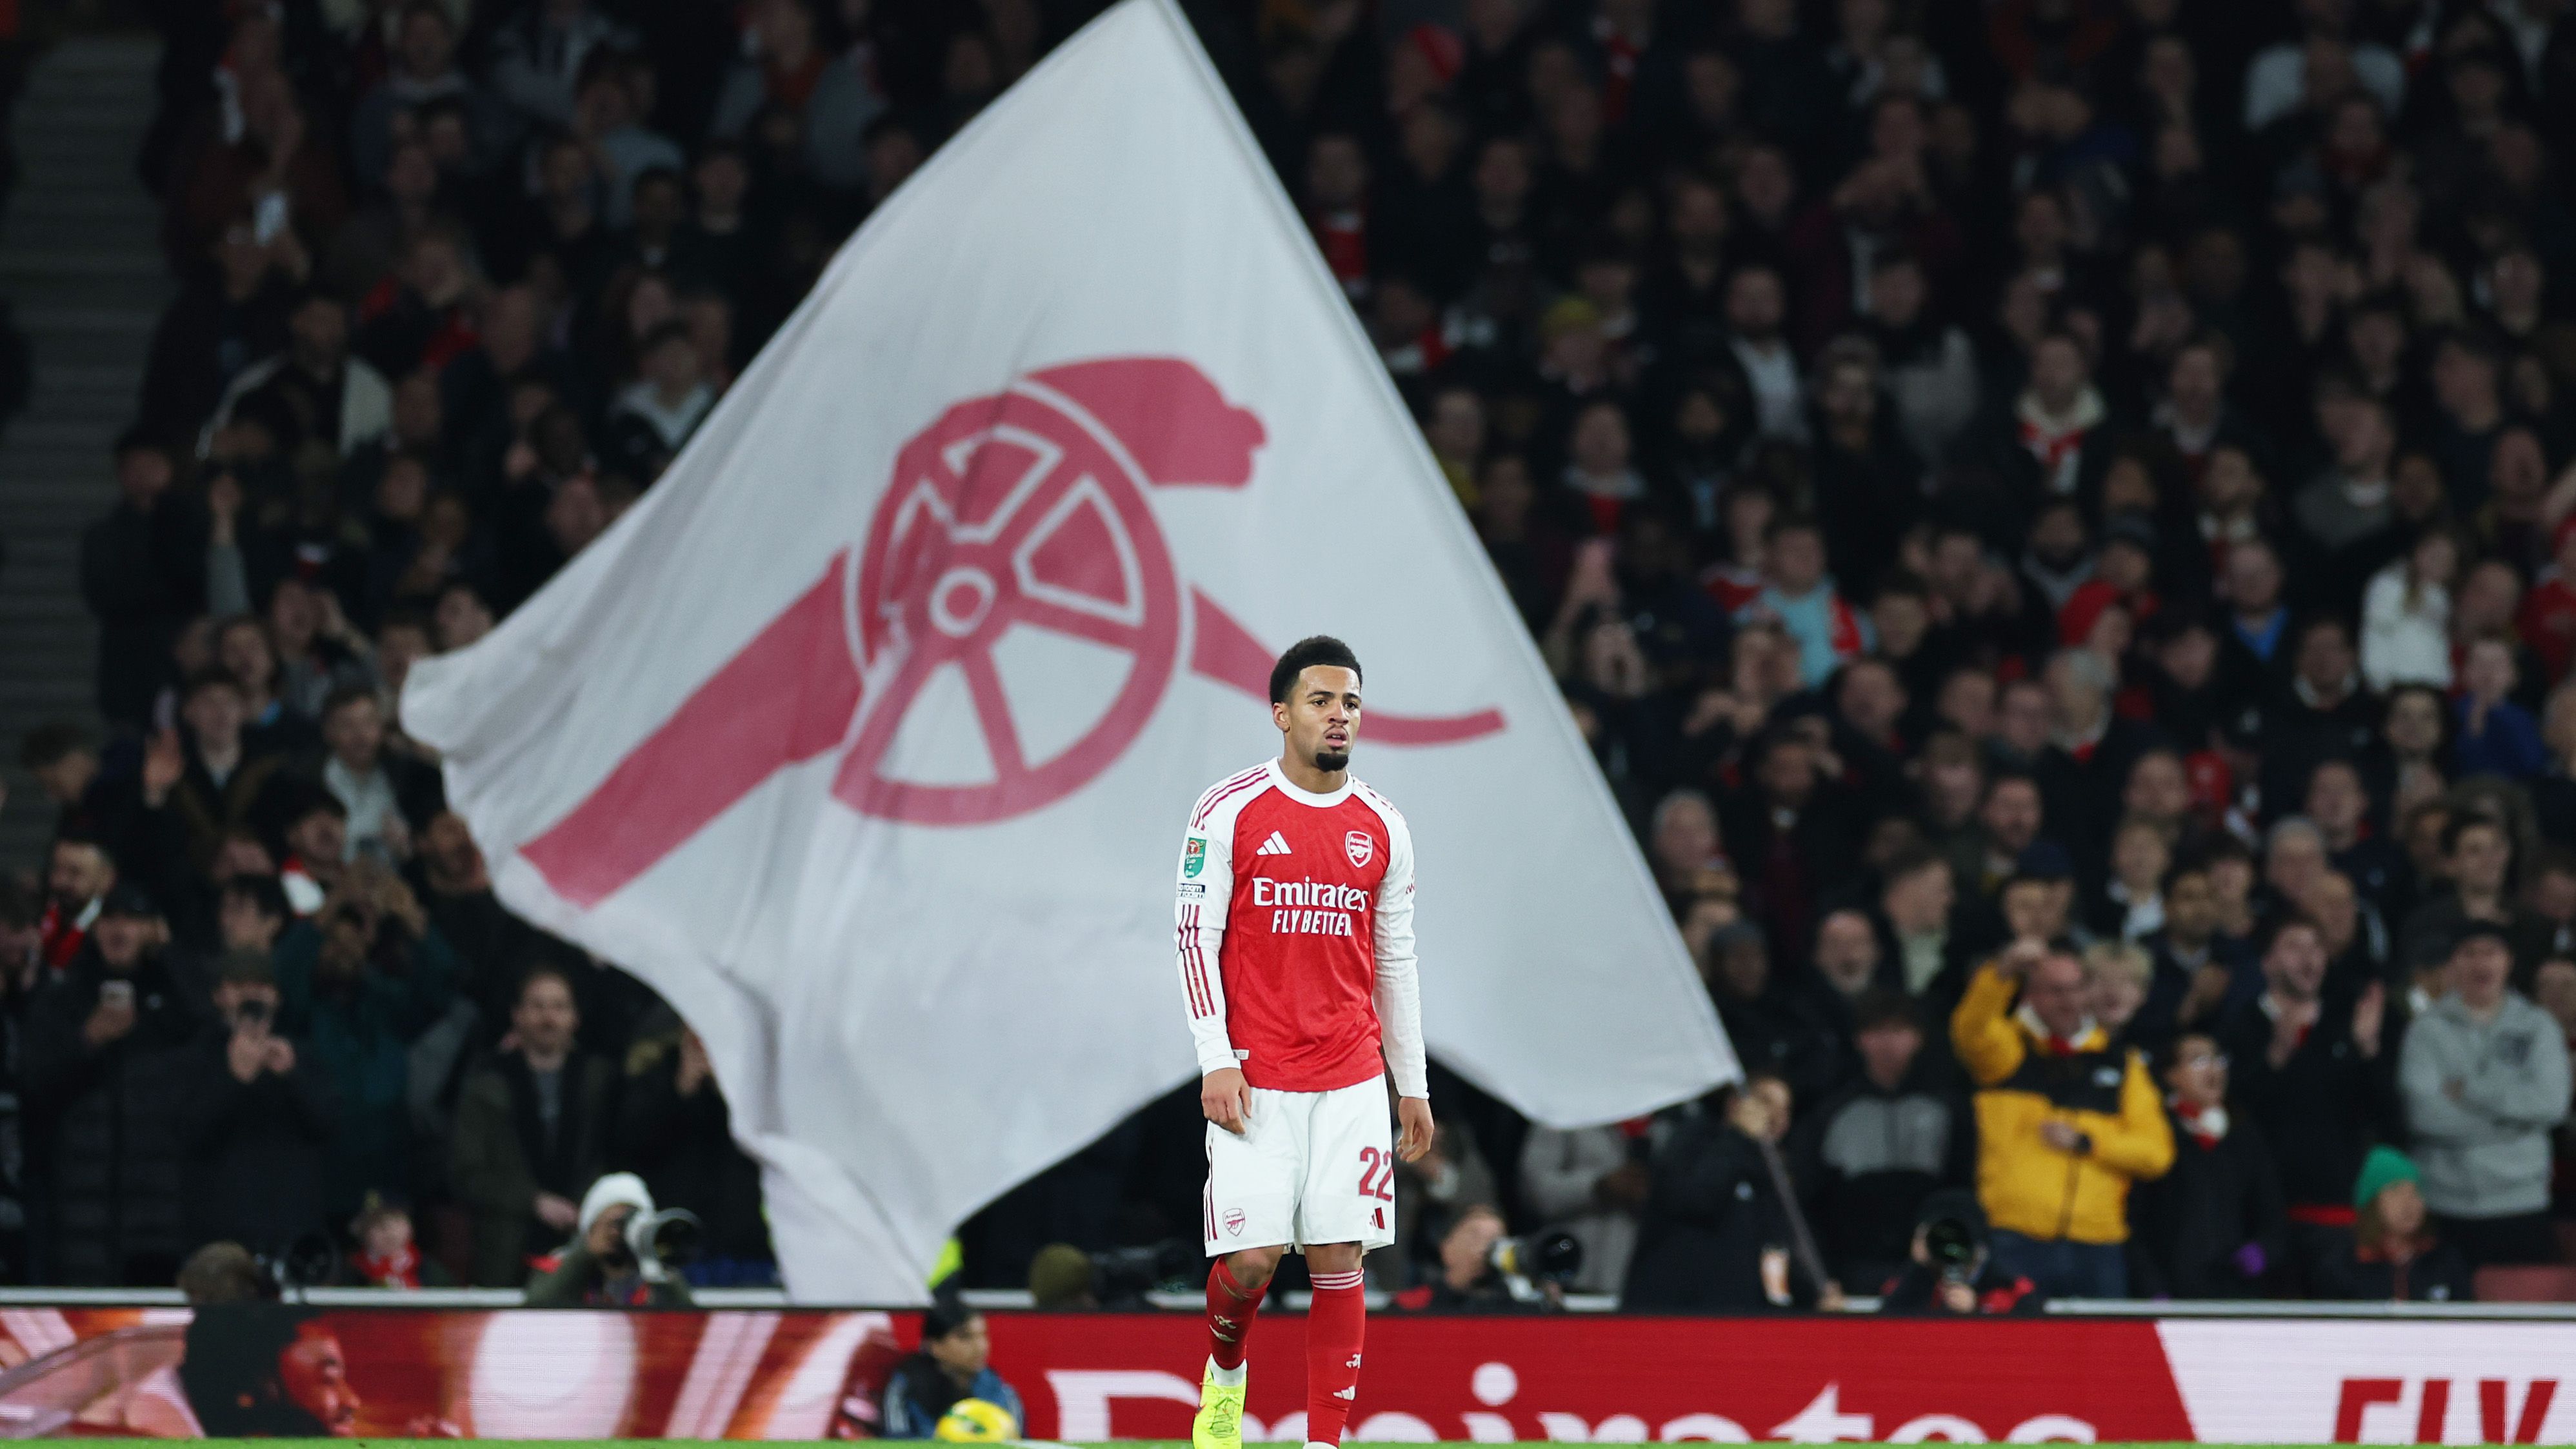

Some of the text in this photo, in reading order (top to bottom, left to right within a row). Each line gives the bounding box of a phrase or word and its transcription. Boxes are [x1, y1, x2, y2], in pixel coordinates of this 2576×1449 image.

[1252, 875, 1368, 912] Emirates
[1272, 910, 1352, 936] FLY BETTER
[1359, 1146, 1393, 1202] 22
